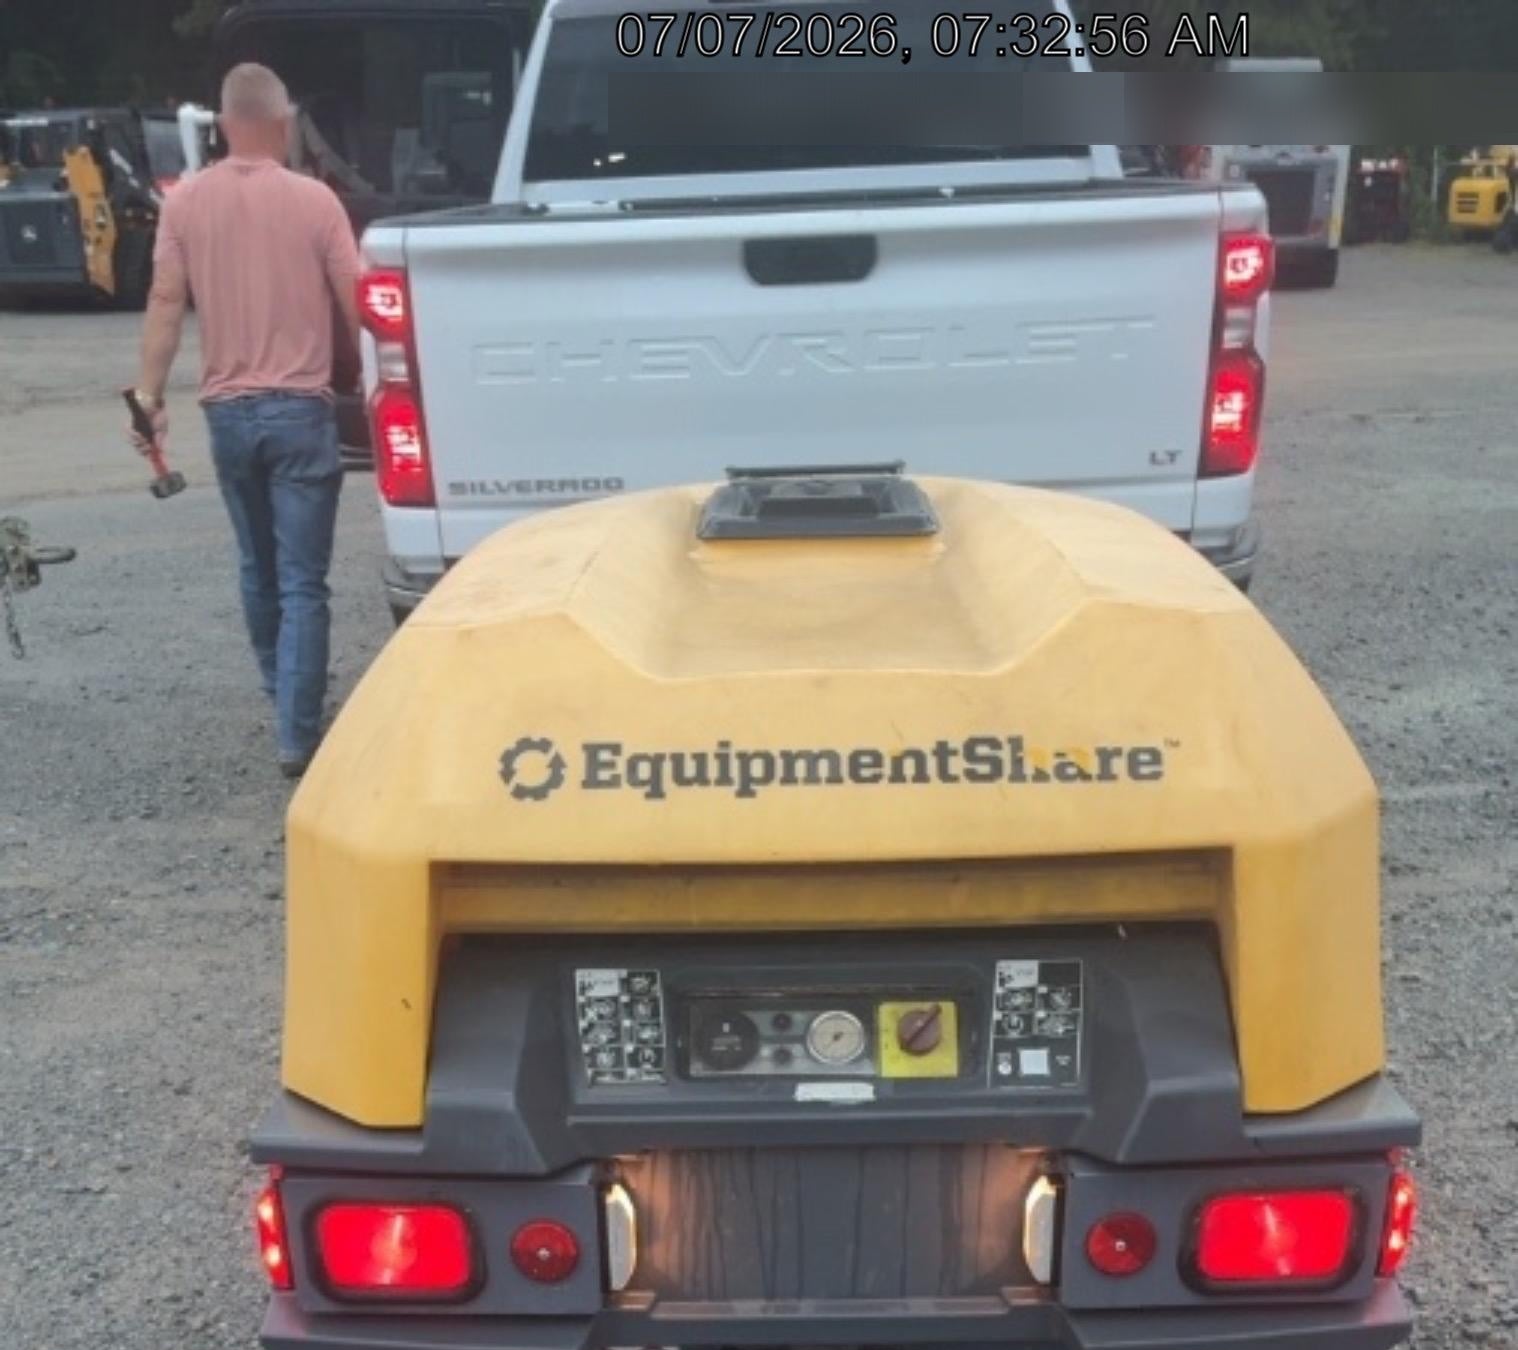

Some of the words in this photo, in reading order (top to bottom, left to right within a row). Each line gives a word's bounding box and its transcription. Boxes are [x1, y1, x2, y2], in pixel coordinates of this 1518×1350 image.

[471, 315, 1156, 385] CHEVROLET
[1149, 449, 1183, 466] LT
[448, 476, 625, 496] SILVERADO
